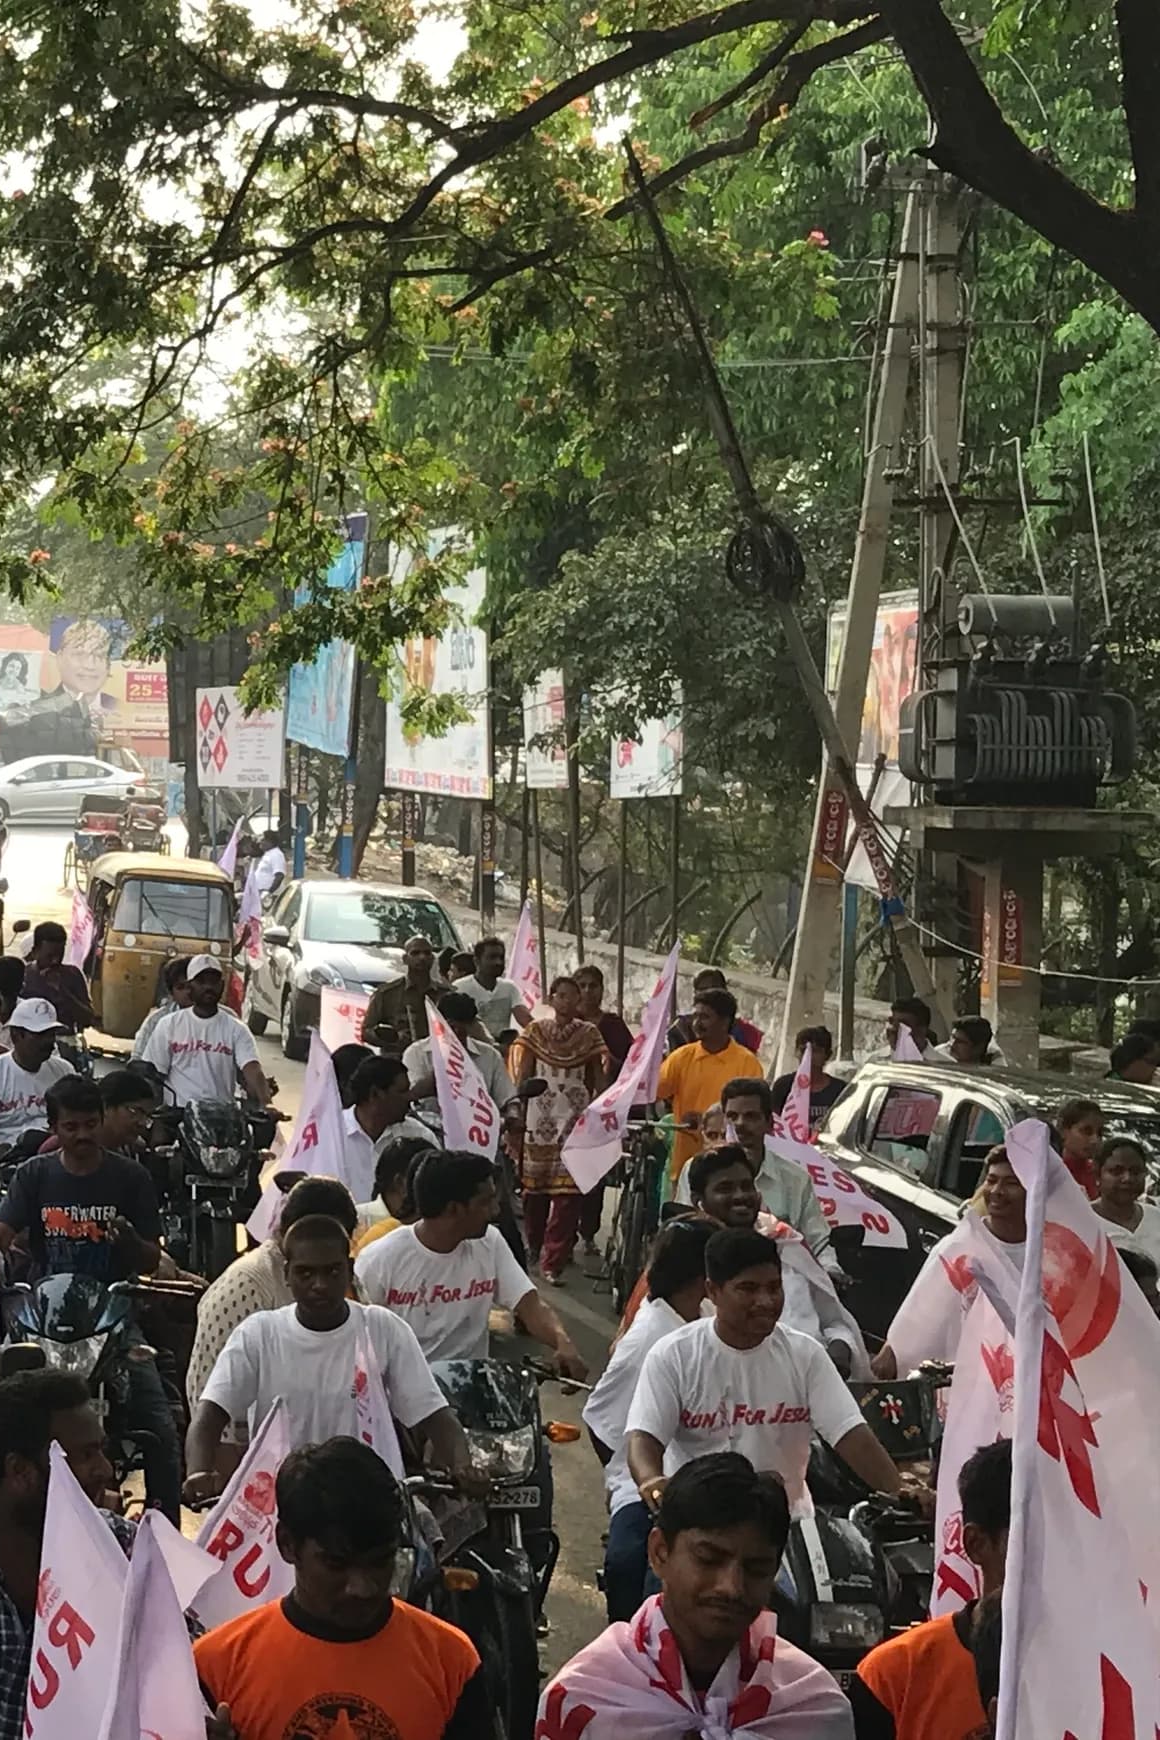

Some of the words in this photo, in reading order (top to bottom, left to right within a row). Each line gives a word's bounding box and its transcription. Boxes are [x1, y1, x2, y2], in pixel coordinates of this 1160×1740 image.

[386, 1287, 418, 1306] RUN
[429, 1284, 462, 1304] FOR
[463, 1279, 496, 1300] JESU
[679, 1409, 718, 1429] RUN
[732, 1403, 767, 1426] FOR
[206, 1518, 271, 1598] RU
